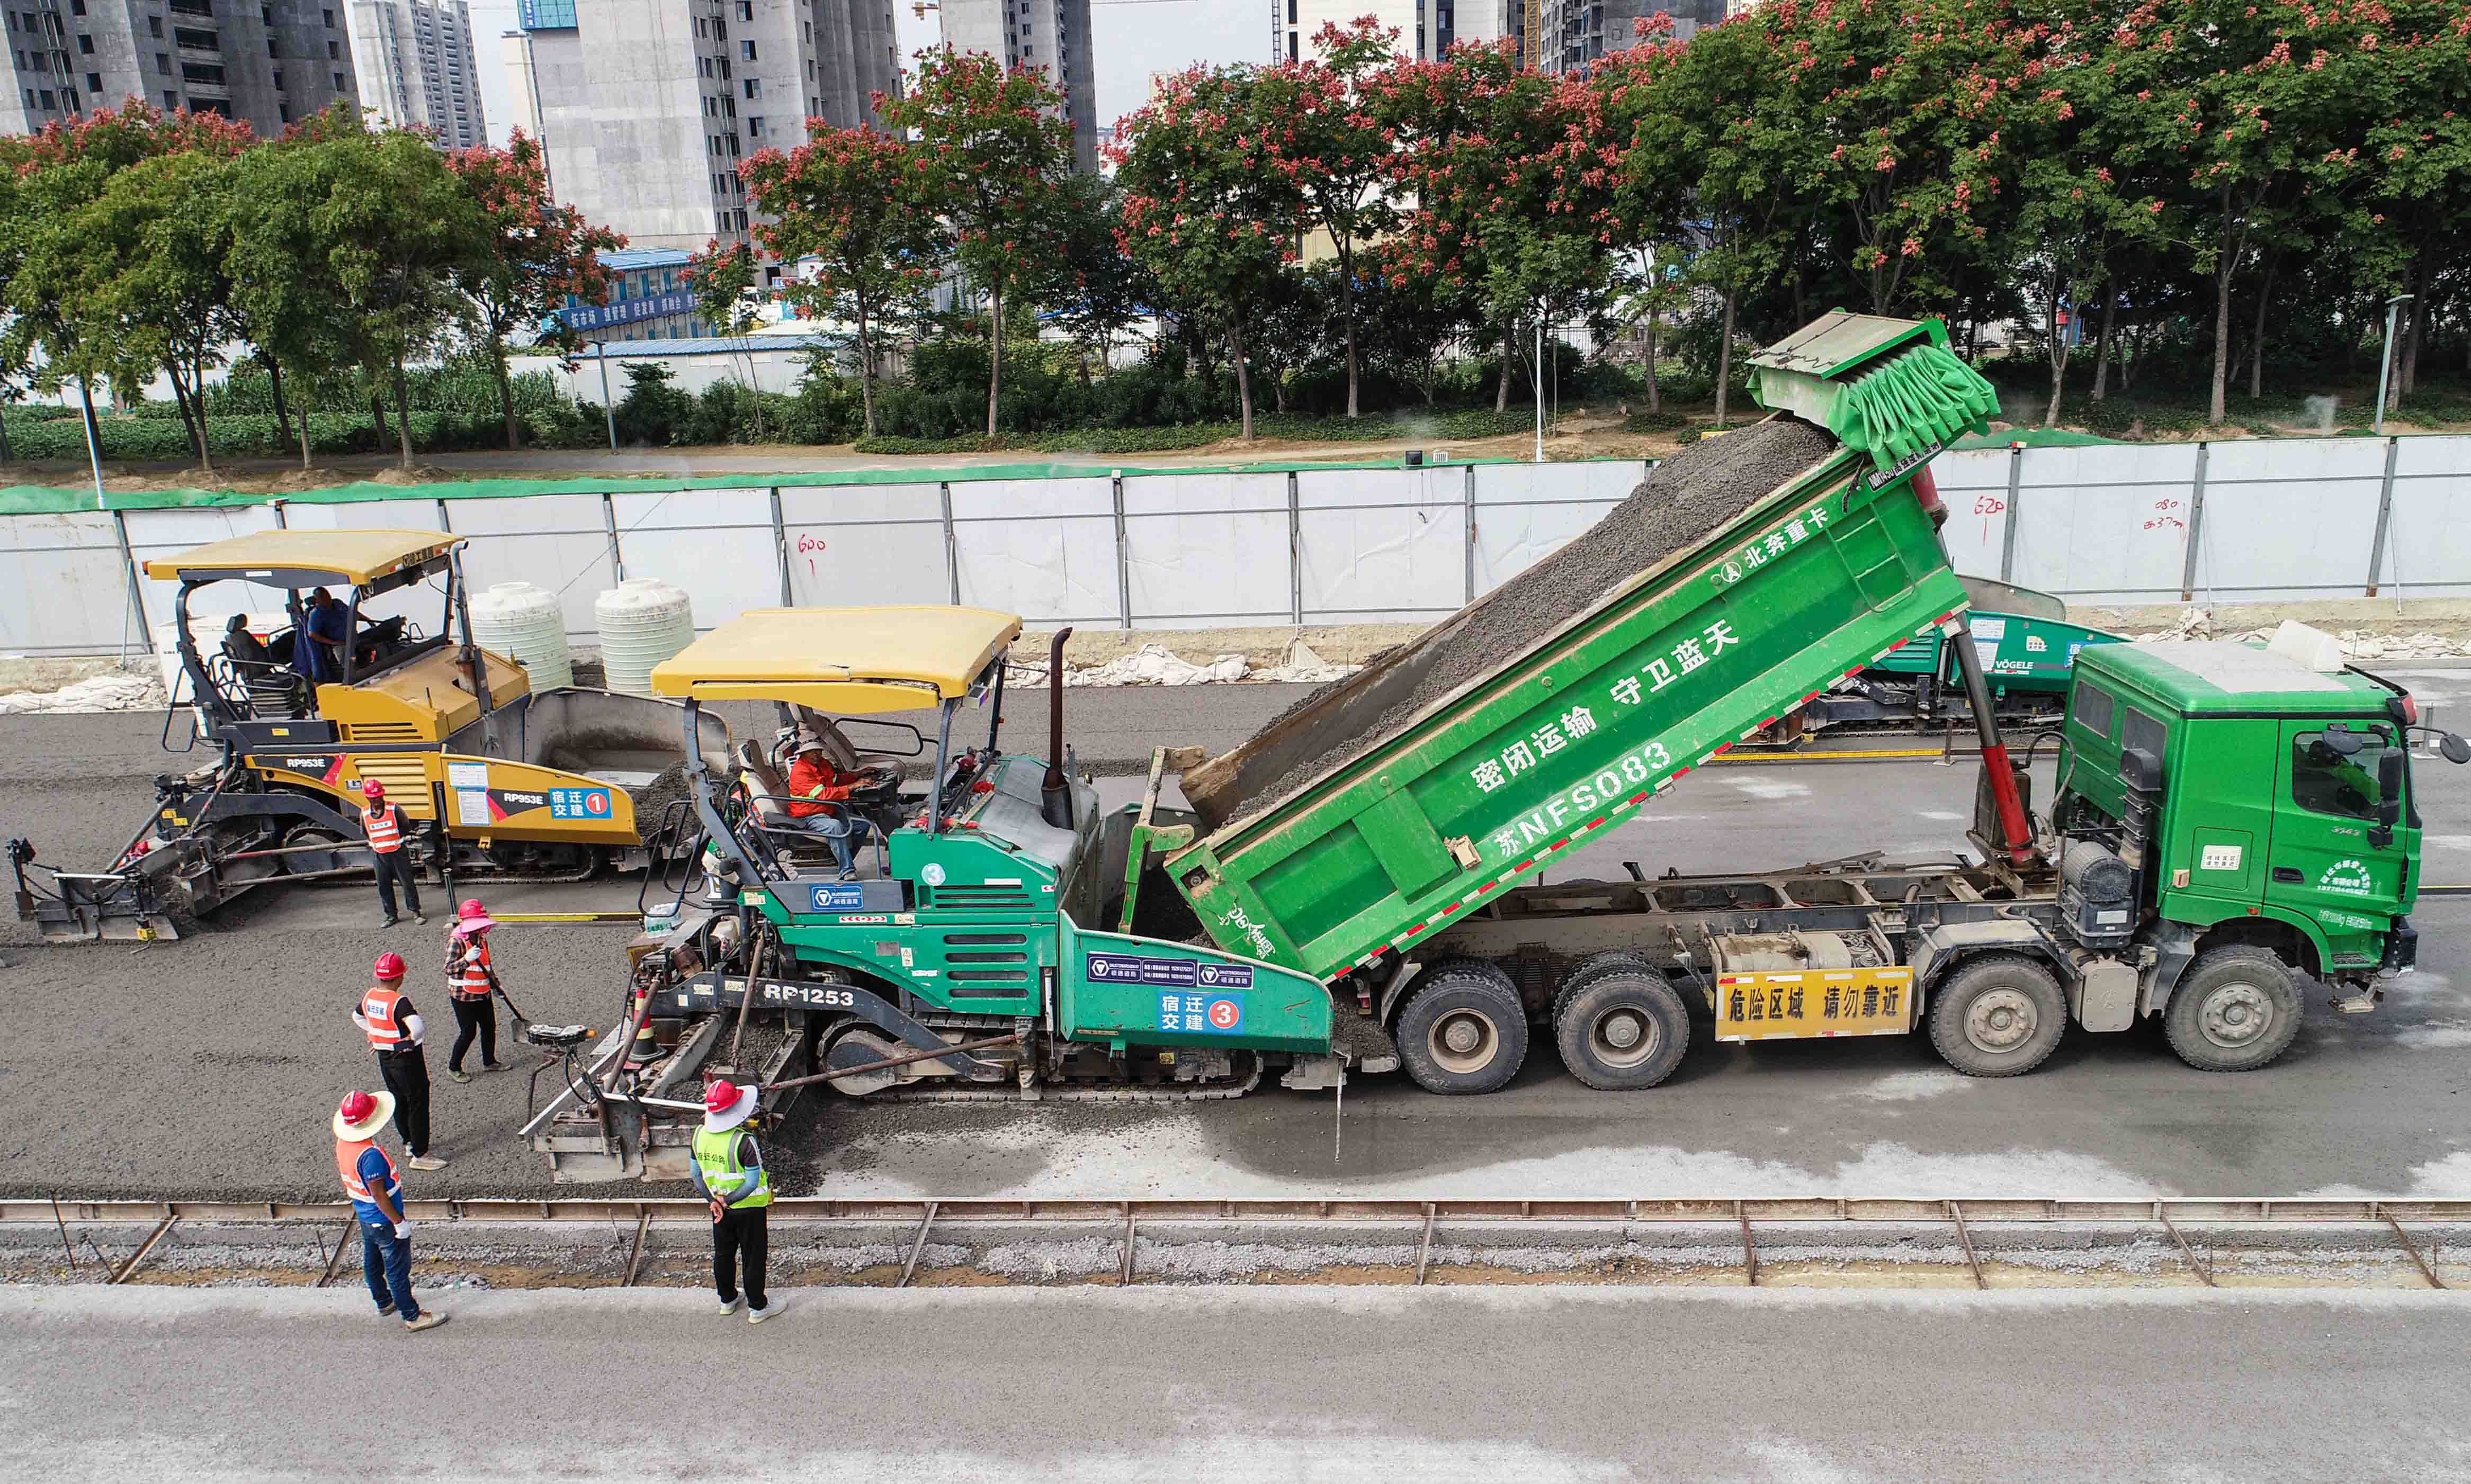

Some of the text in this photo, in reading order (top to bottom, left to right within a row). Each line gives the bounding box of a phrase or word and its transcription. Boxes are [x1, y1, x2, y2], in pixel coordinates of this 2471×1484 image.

[1974, 496, 2004, 515] 620
[798, 533, 826, 553] 600
[1745, 507, 1828, 569] 北奔重卡
[1995, 659, 2034, 669] VÖGELE
[1470, 618, 1740, 793] 密闭运输 守卫蓝天
[287, 758, 326, 768] RP953E
[504, 793, 544, 805] RP953E
[552, 791, 601, 812] 宿迁 1
[1494, 742, 1671, 858] 苏NFS083
[554, 804, 585, 816] 交建
[764, 984, 854, 1006] RP1253
[1729, 984, 1899, 1021] 危险区域 请勿靠近
[1161, 995, 1232, 1024] 宿迁 3
[1161, 1013, 1204, 1031] 交建
